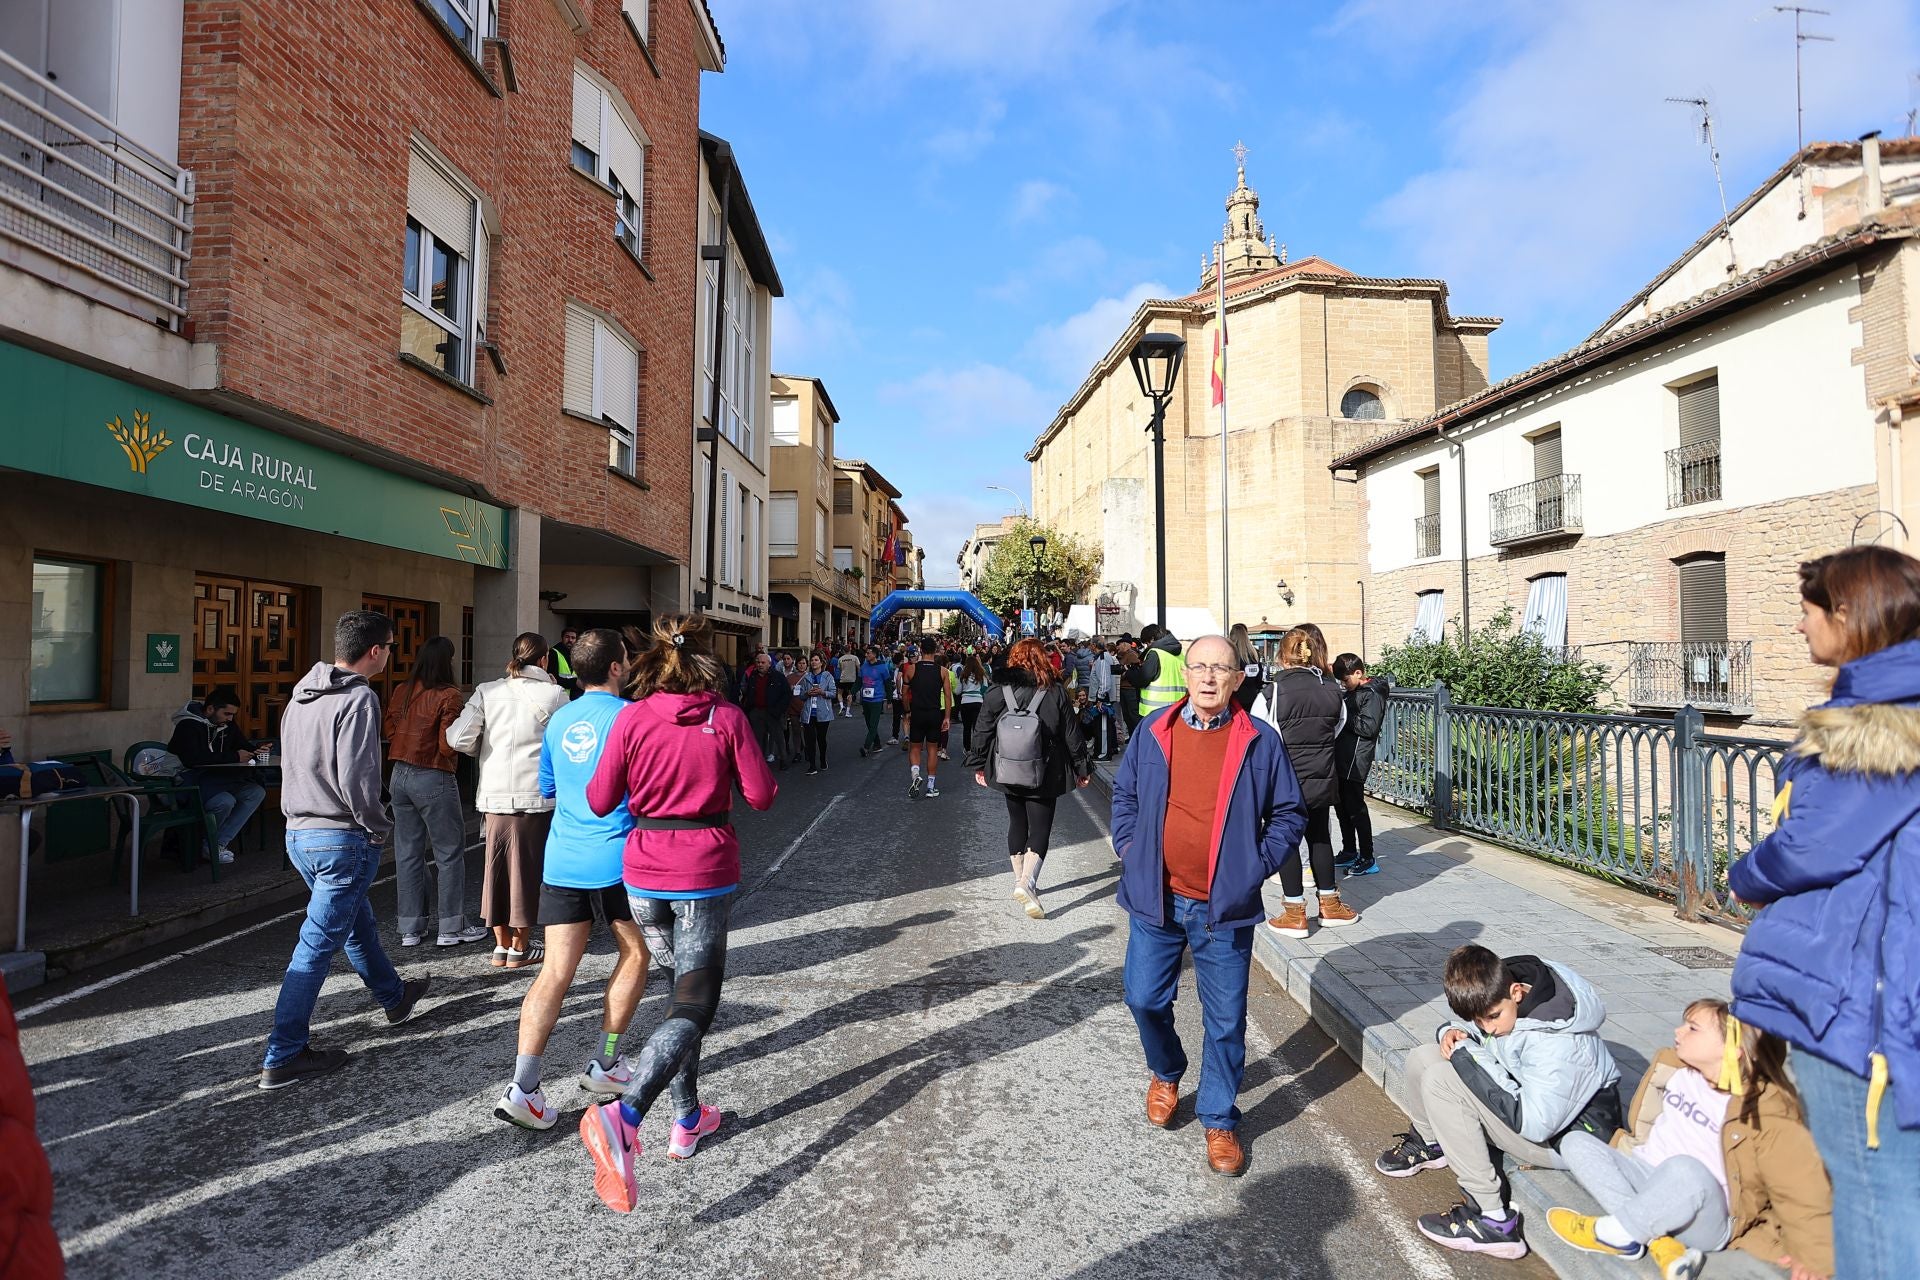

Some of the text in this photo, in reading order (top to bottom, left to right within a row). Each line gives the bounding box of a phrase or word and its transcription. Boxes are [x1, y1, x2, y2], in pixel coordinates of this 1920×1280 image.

[183, 432, 318, 491] CAJA RURAL
[199, 470, 305, 511] DE ARAGÓN
